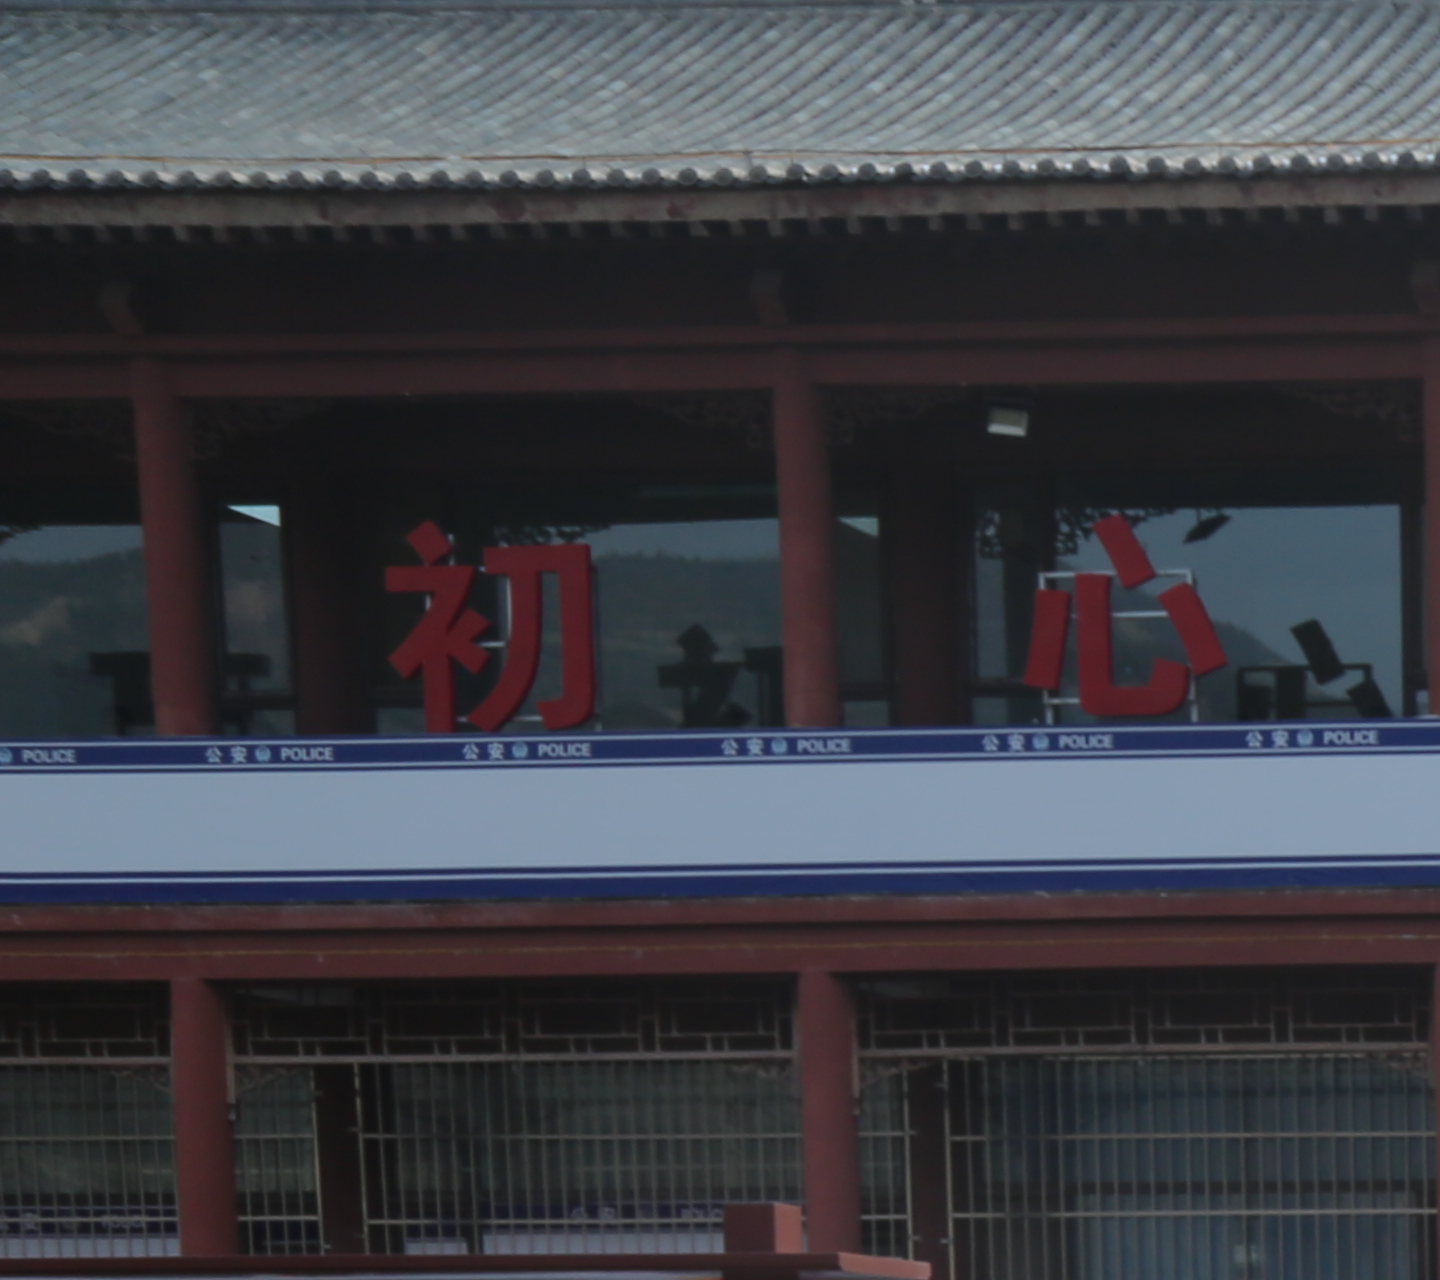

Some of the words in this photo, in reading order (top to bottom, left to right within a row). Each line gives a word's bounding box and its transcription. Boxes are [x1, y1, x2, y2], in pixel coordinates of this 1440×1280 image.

[385, 520, 596, 732] 初
[1022, 514, 1227, 716] 心
[721, 738, 764, 755] 公安
[797, 738, 853, 754] POLICE
[982, 733, 1026, 752] 公安
[1058, 734, 1115, 750] POLICE
[1245, 729, 1290, 748] 公安
[1322, 729, 1379, 746] POLICE
[21, 748, 77, 764] POLICE
[205, 746, 249, 764] 公安
[280, 747, 334, 763] POLICE
[462, 743, 505, 760] 公安
[538, 743, 592, 759] POLICE
